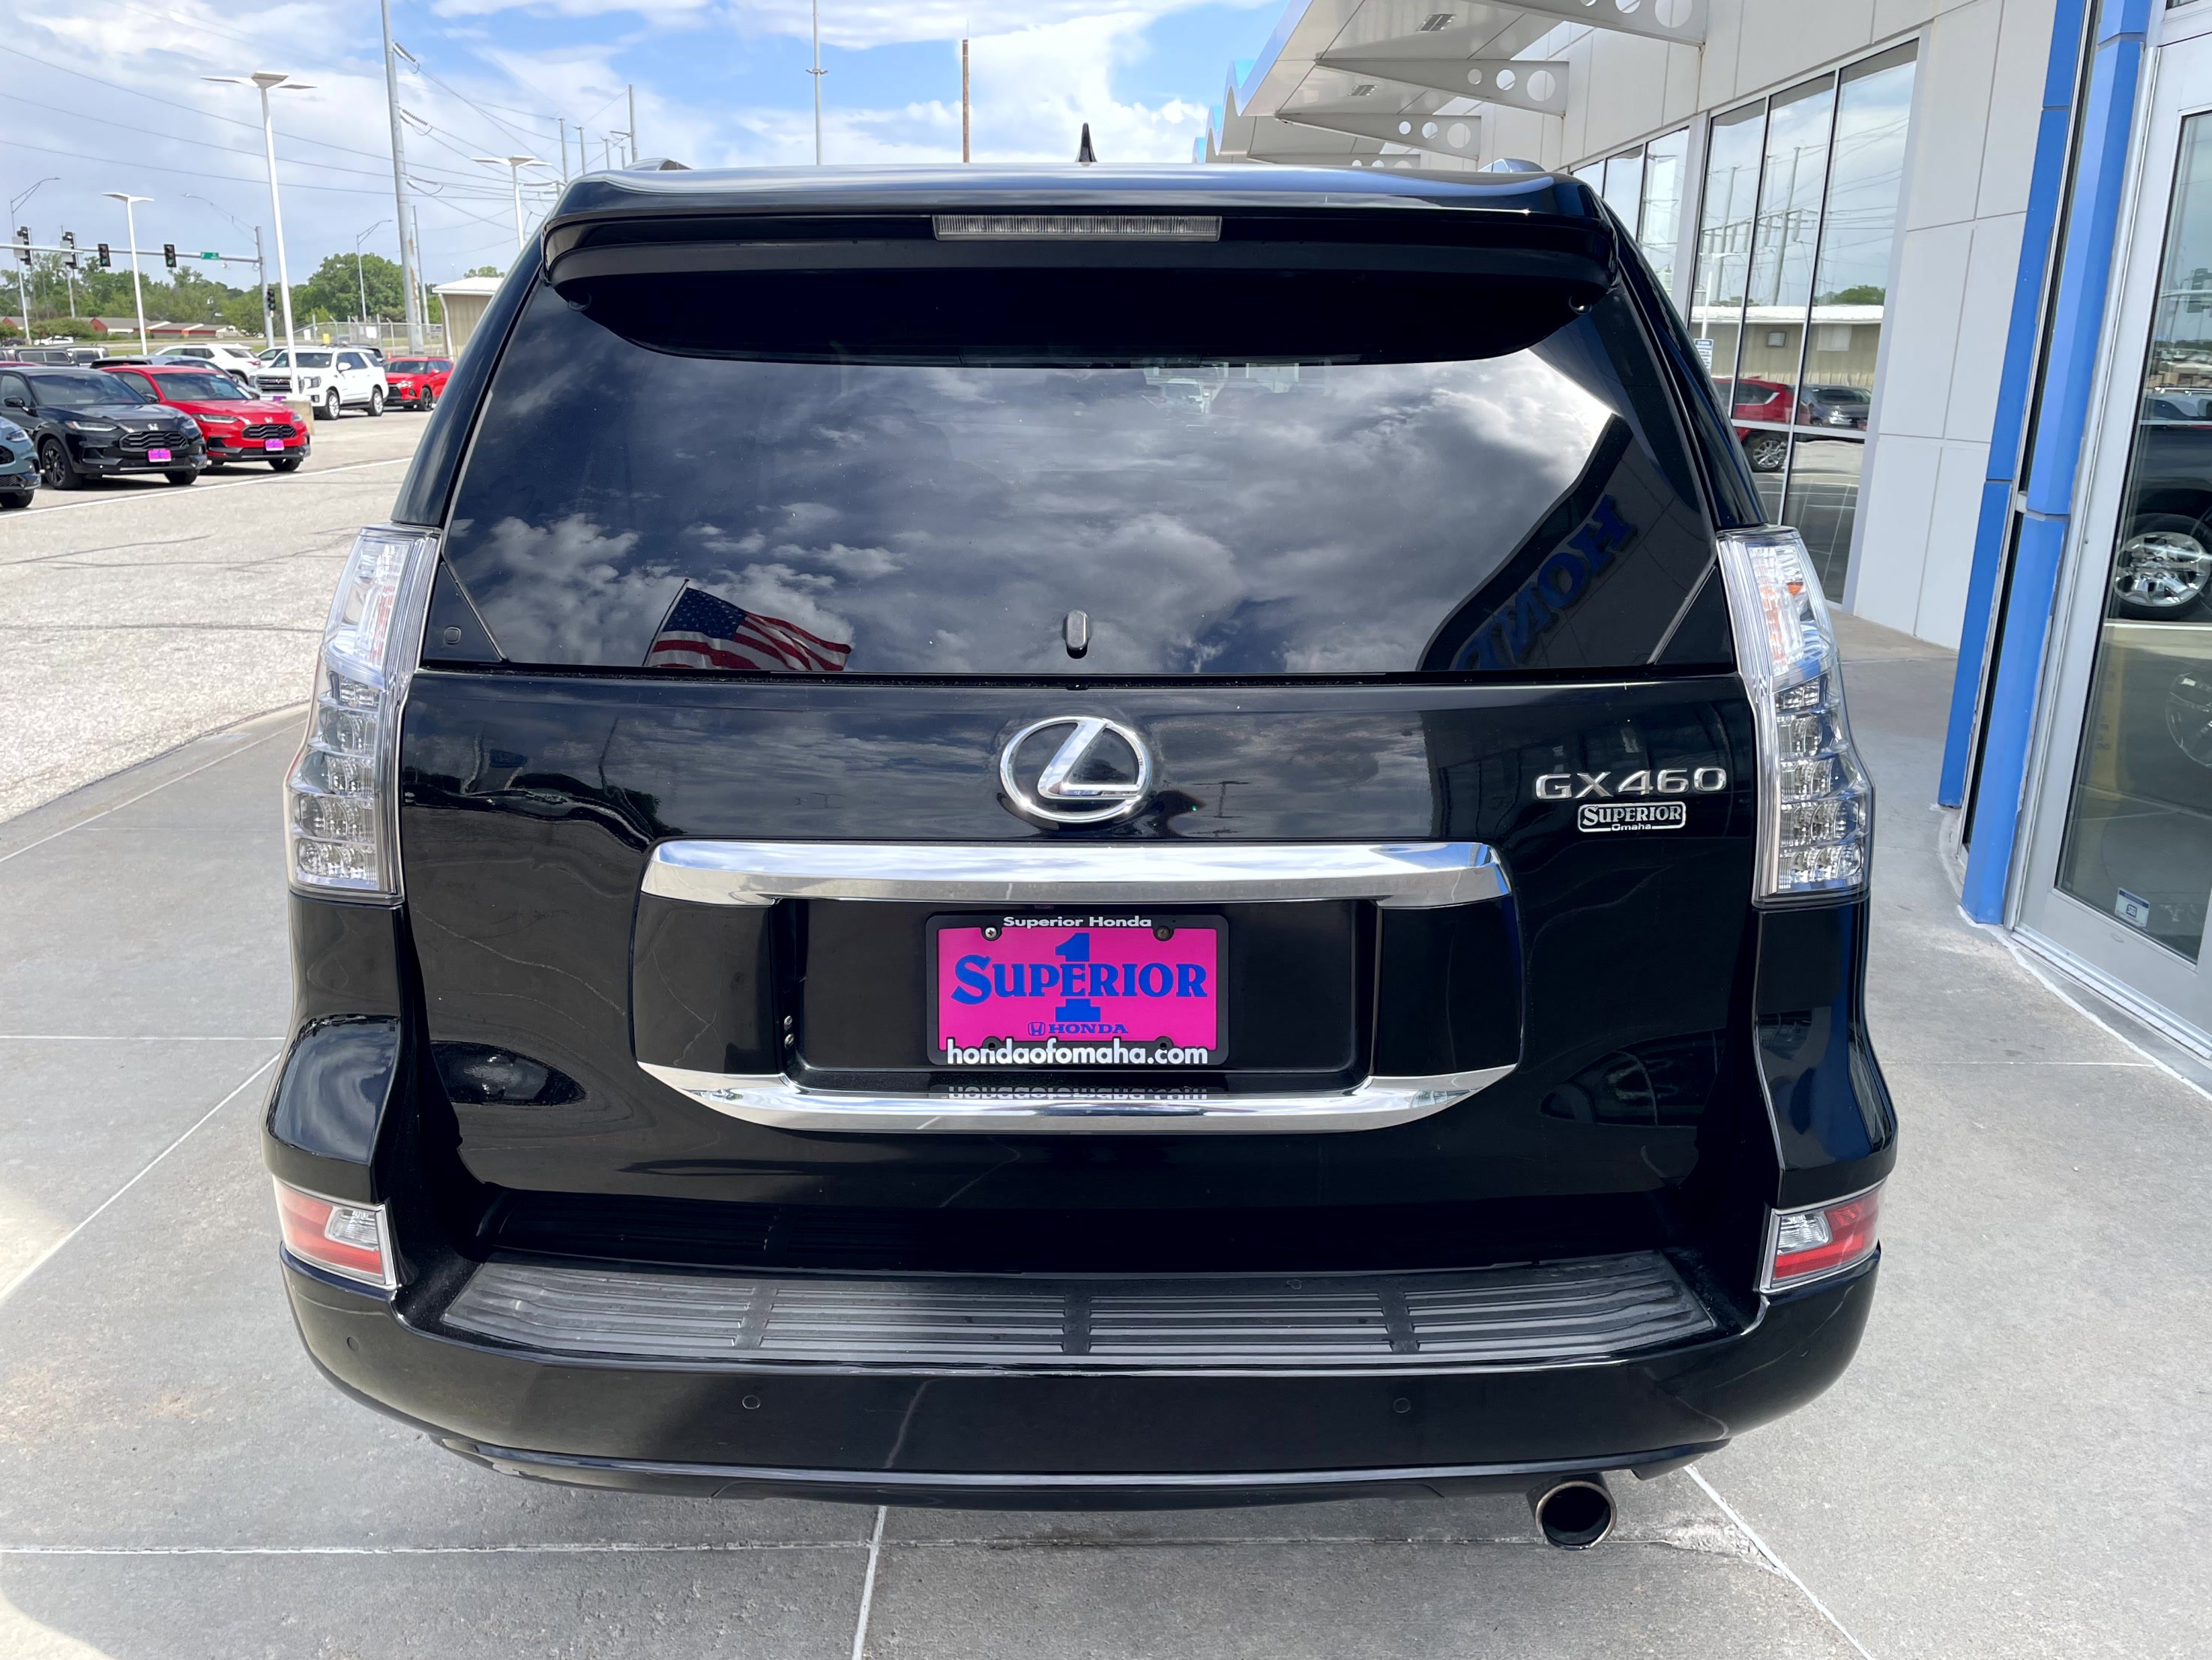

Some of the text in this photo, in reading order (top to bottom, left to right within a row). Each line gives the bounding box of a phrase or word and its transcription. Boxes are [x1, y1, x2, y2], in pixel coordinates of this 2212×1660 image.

[1582, 805, 1681, 826] SUPERIOR
[1612, 823, 1653, 831] Omaha
[1003, 915, 1151, 929] Superior Honda
[951, 954, 1208, 1005] SUPERIOR
[1049, 1023, 1128, 1034] HONDA
[947, 1038, 1208, 1065] hondaofomaha.com
